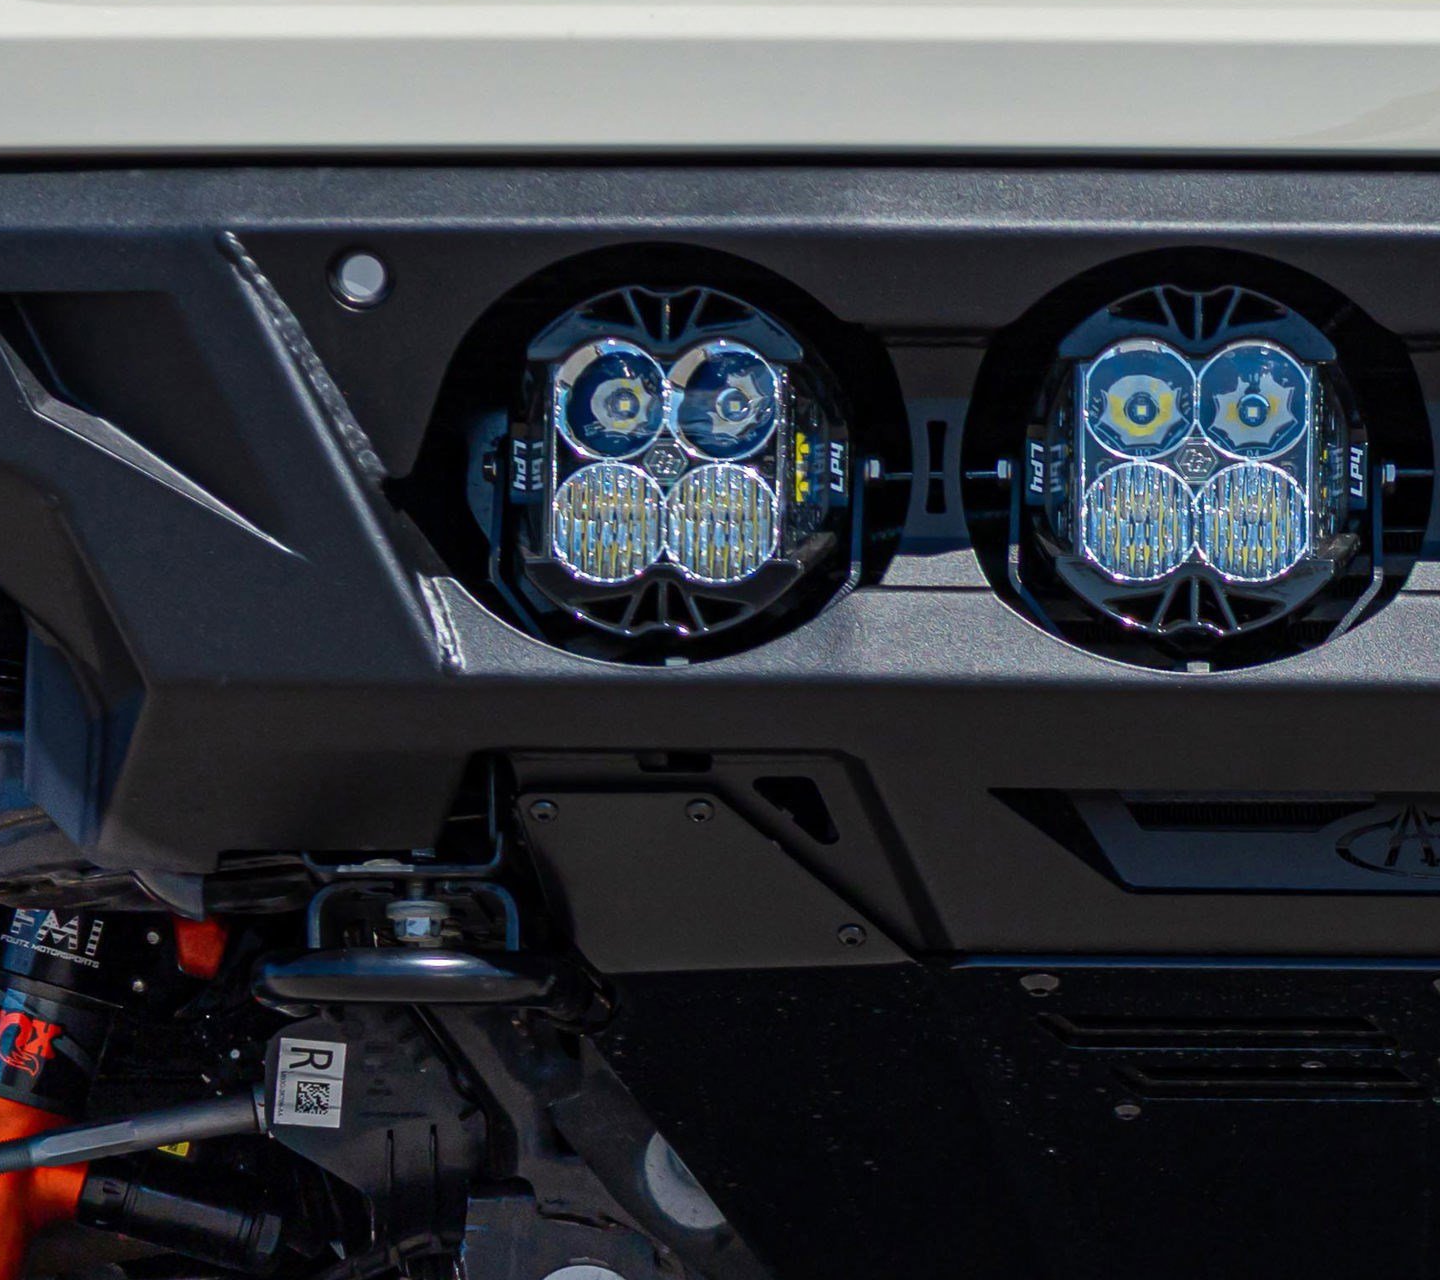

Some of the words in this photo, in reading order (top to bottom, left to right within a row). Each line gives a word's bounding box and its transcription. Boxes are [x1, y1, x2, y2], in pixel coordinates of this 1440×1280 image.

[512, 439, 528, 491] LP4
[829, 441, 845, 494] LP4
[1029, 441, 1045, 493] LP4
[1348, 444, 1365, 497] LP4
[0, 933, 30, 949] FOUTZ
[31, 942, 101, 969] MOTORSPORTS
[288, 1046, 334, 1070] R
